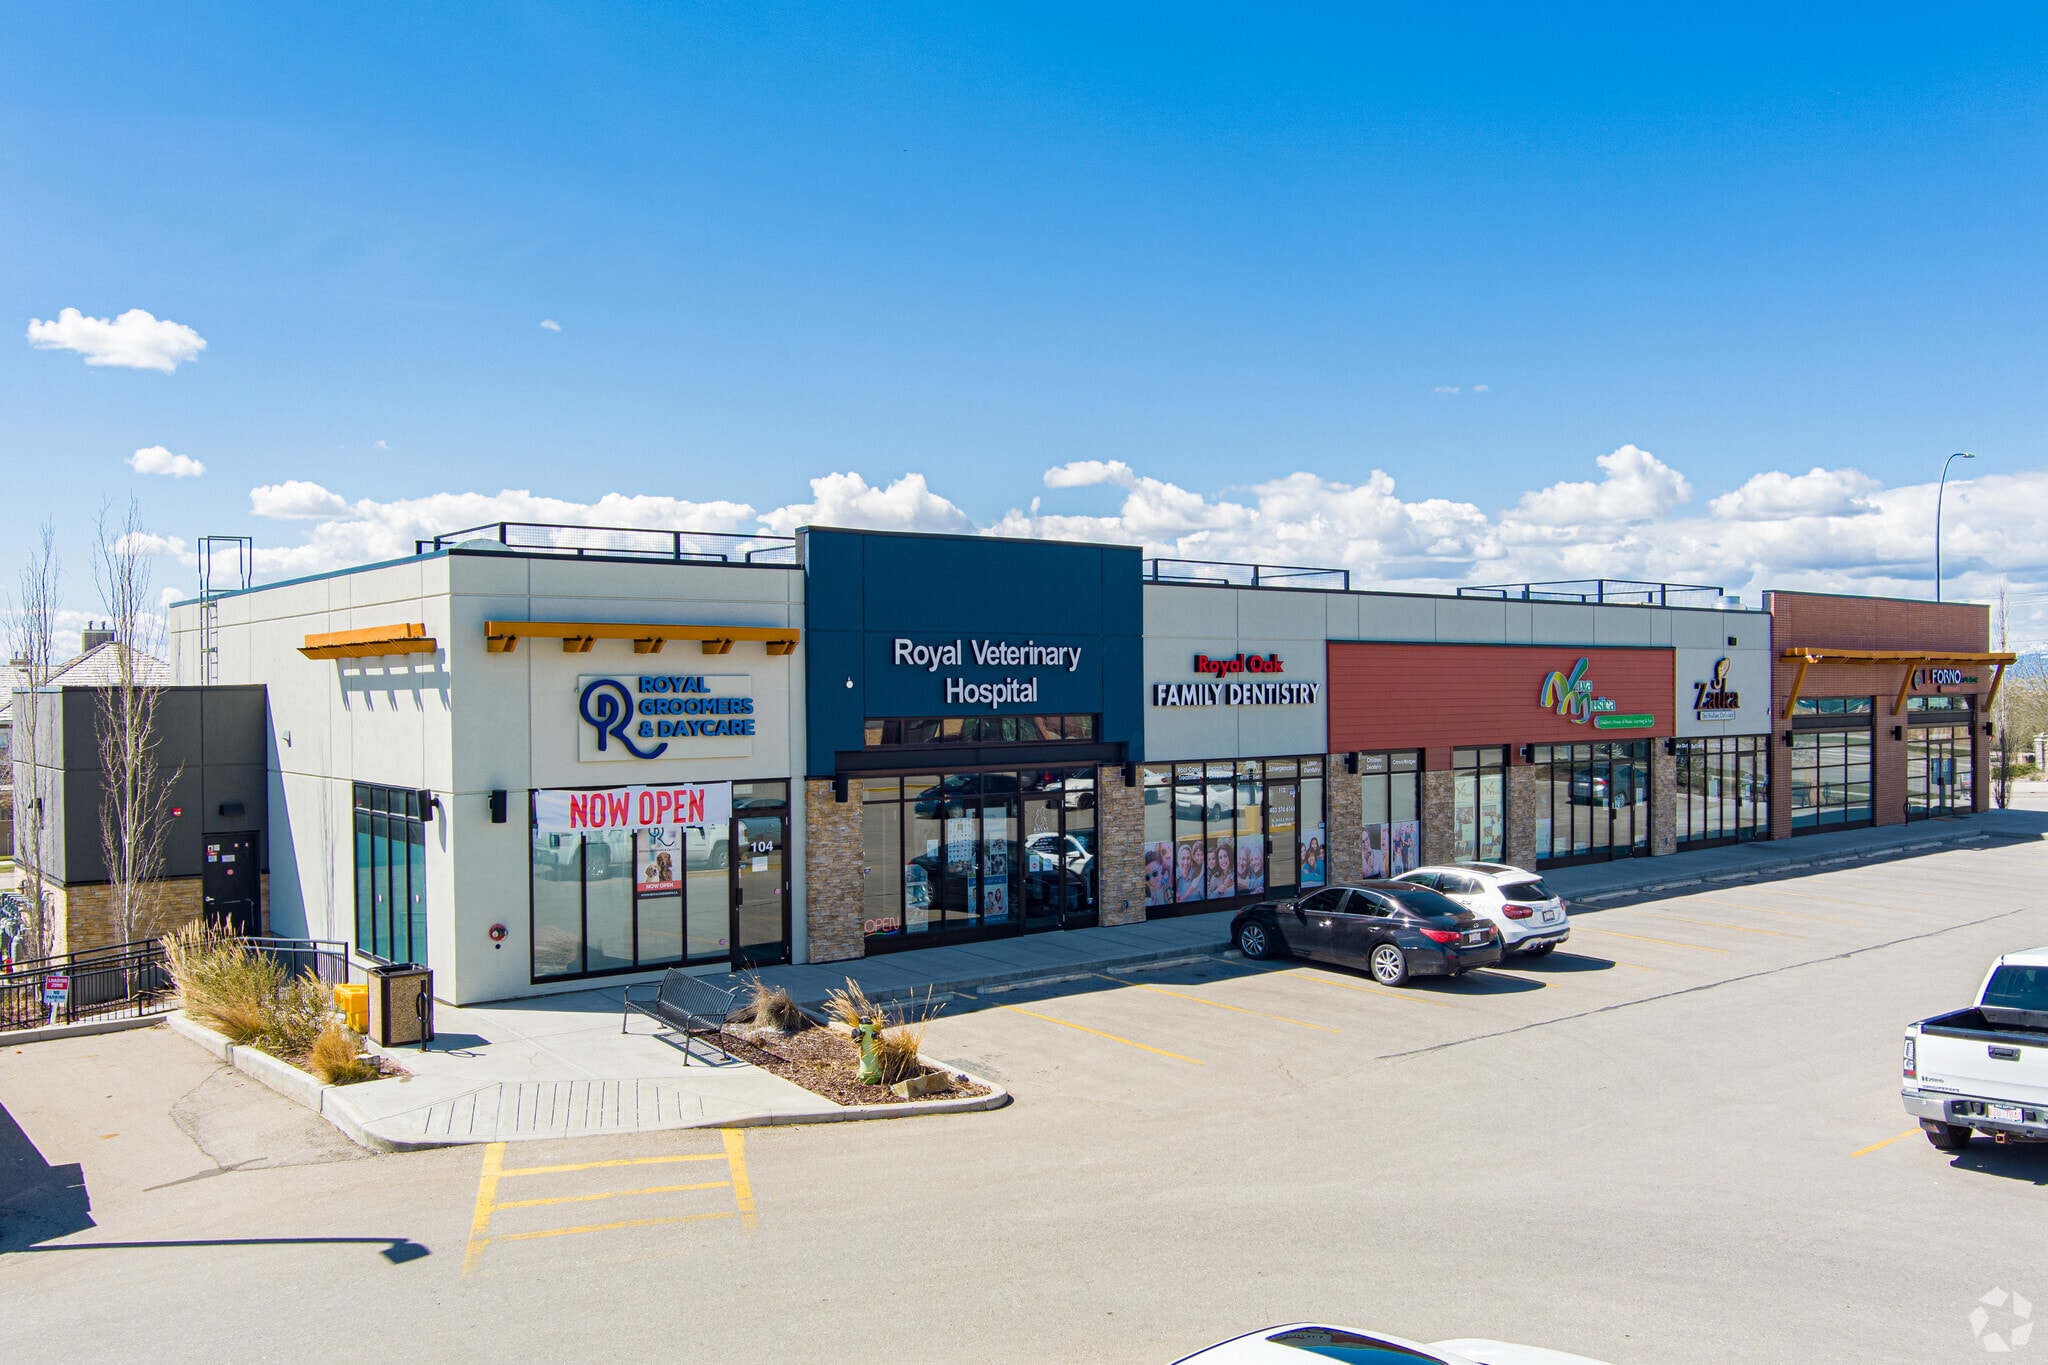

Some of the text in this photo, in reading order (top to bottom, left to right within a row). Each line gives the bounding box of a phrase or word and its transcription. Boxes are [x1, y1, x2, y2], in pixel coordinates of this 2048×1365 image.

[894, 638, 1082, 672] Royal Veterinary
[1196, 653, 1284, 678] Royal Oak
[638, 676, 711, 693] ROYAL
[1932, 669, 1962, 684] FORNO
[946, 677, 1038, 709] Hospital
[1156, 683, 1320, 706] FAMILY DENTISTRY
[638, 697, 755, 716] GROOMERS
[638, 719, 756, 738] & DAYCARE
[569, 788, 706, 829] NOW OPEN
[751, 841, 774, 853] 104
[864, 917, 900, 933] OPEN
